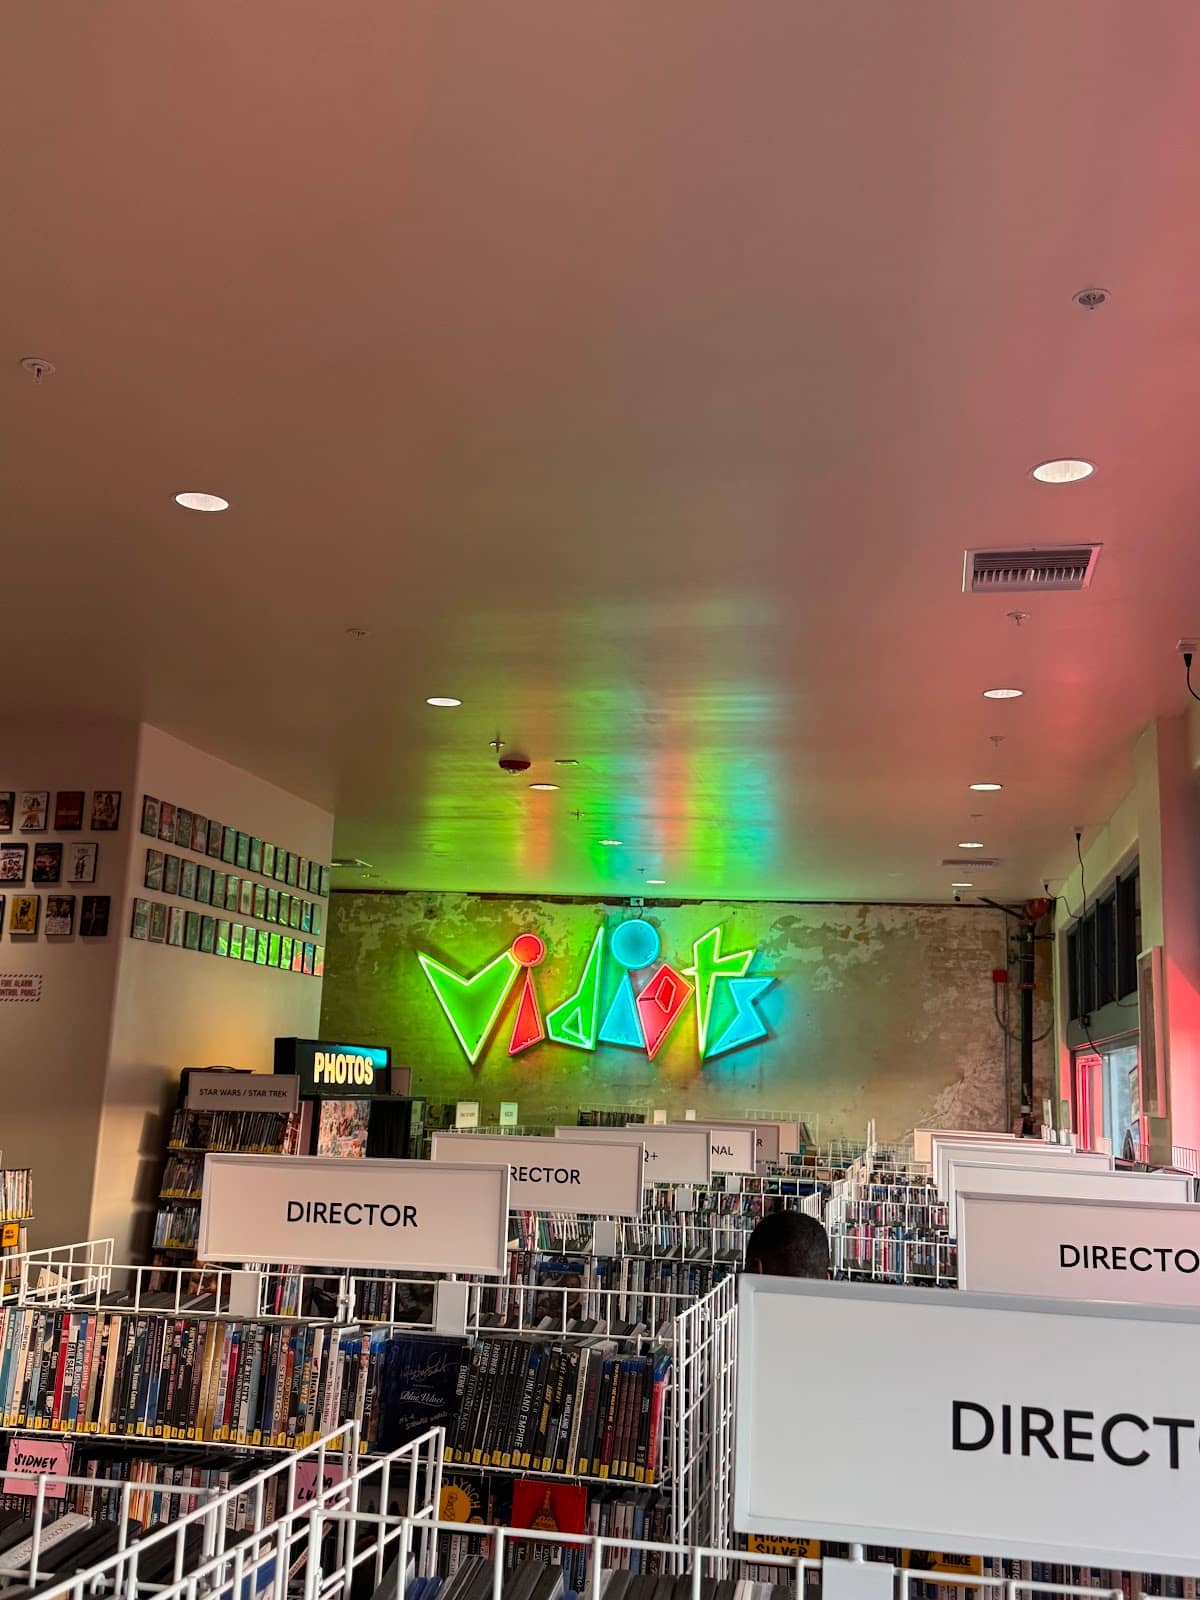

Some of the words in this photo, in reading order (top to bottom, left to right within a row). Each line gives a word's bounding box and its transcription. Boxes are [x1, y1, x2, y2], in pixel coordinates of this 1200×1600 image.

[313, 1052, 374, 1086] PHOTOS
[199, 1088, 218, 1096] STAR
[219, 1088, 241, 1097] WARS
[248, 1089, 267, 1097] STAR
[510, 1166, 581, 1185] RECTOR
[286, 1200, 418, 1228] DIRECTOR
[1059, 1243, 1200, 1274] DIRECTO
[67, 1342, 76, 1359] FAIL
[75, 1339, 85, 1366] FAMILY
[186, 1327, 196, 1366] NETWORK
[247, 1330, 257, 1358] PRINCE
[64, 1359, 76, 1377] SAFE
[244, 1367, 252, 1384] THE
[240, 1384, 250, 1404] CITY
[273, 1366, 286, 1419] SERPICO
[364, 1387, 373, 1416] DUNE
[400, 1391, 420, 1401] Blue
[520, 1376, 535, 1413] INLAND
[532, 1383, 543, 1414] LYNCH
[460, 1411, 470, 1432] MAN
[513, 1415, 528, 1448] EMPIRE
[952, 1399, 1200, 1470] DIRECT
[14, 1453, 58, 1470] SIDNEY
[755, 1543, 808, 1558] SILVER
